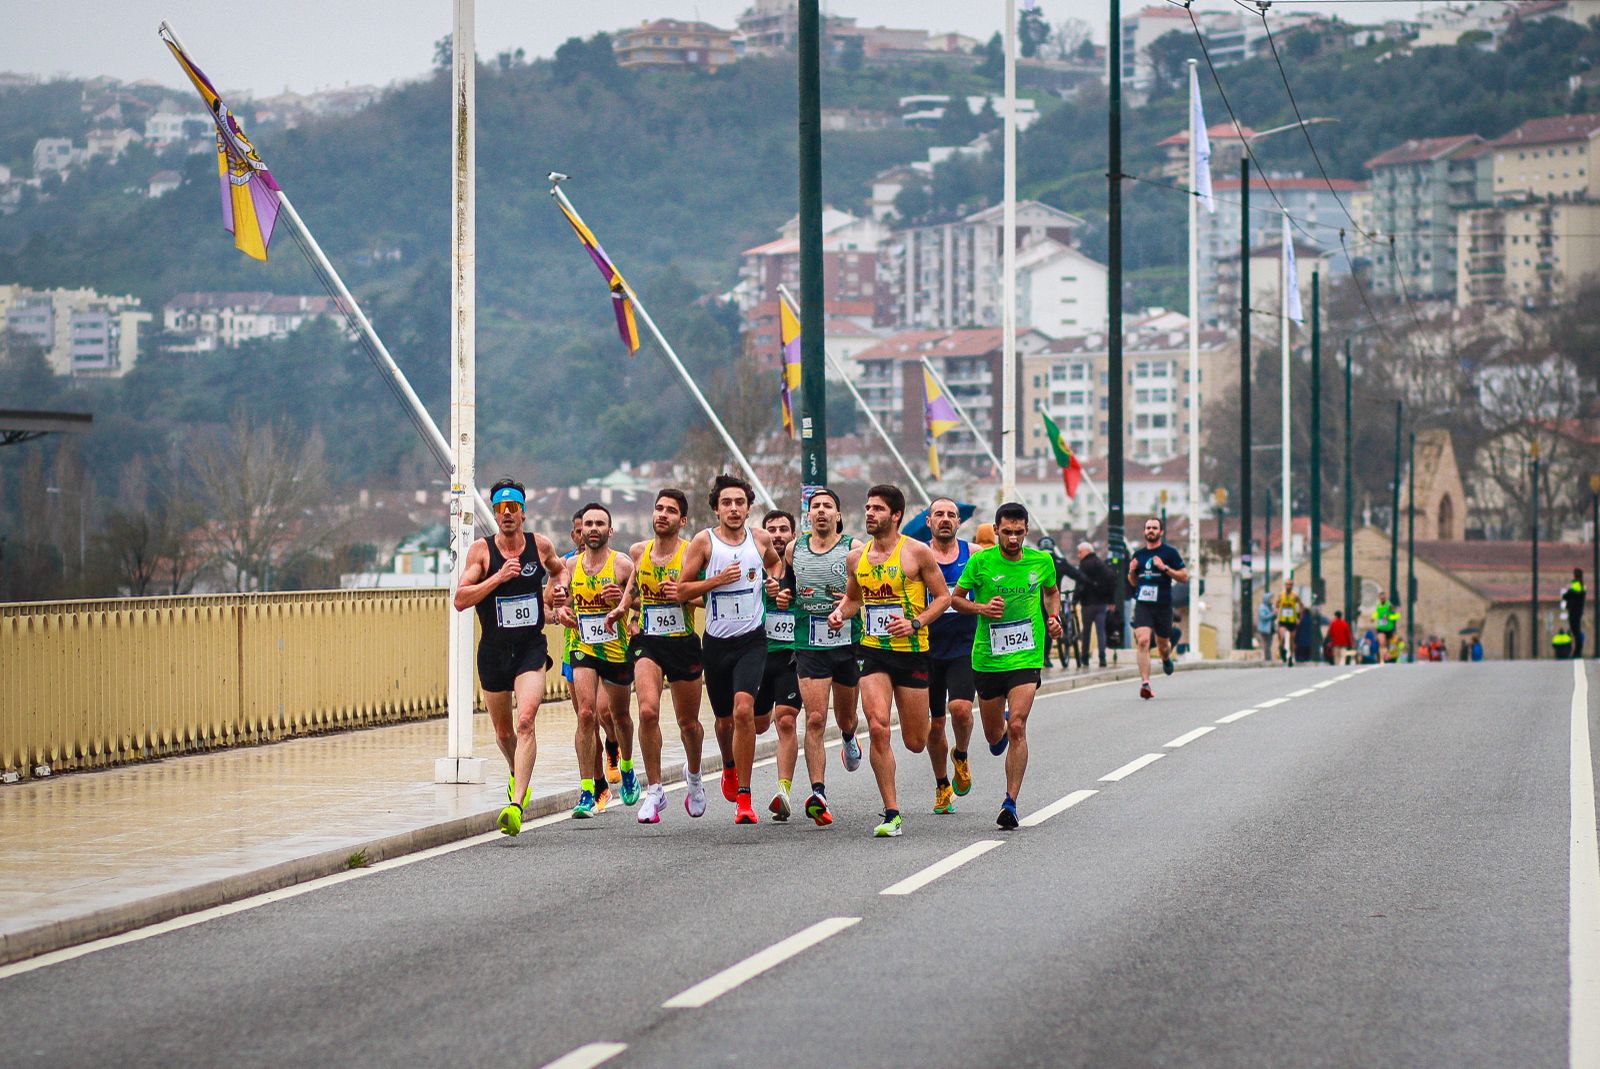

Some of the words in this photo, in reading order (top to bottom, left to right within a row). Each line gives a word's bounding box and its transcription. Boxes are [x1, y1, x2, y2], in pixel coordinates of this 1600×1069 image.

[515, 607, 530, 619] 80
[734, 602, 740, 614] 1
[656, 615, 677, 627] 963
[774, 621, 794, 633] 693
[827, 628, 841, 639] 54
[1004, 632, 1028, 646] 1524
